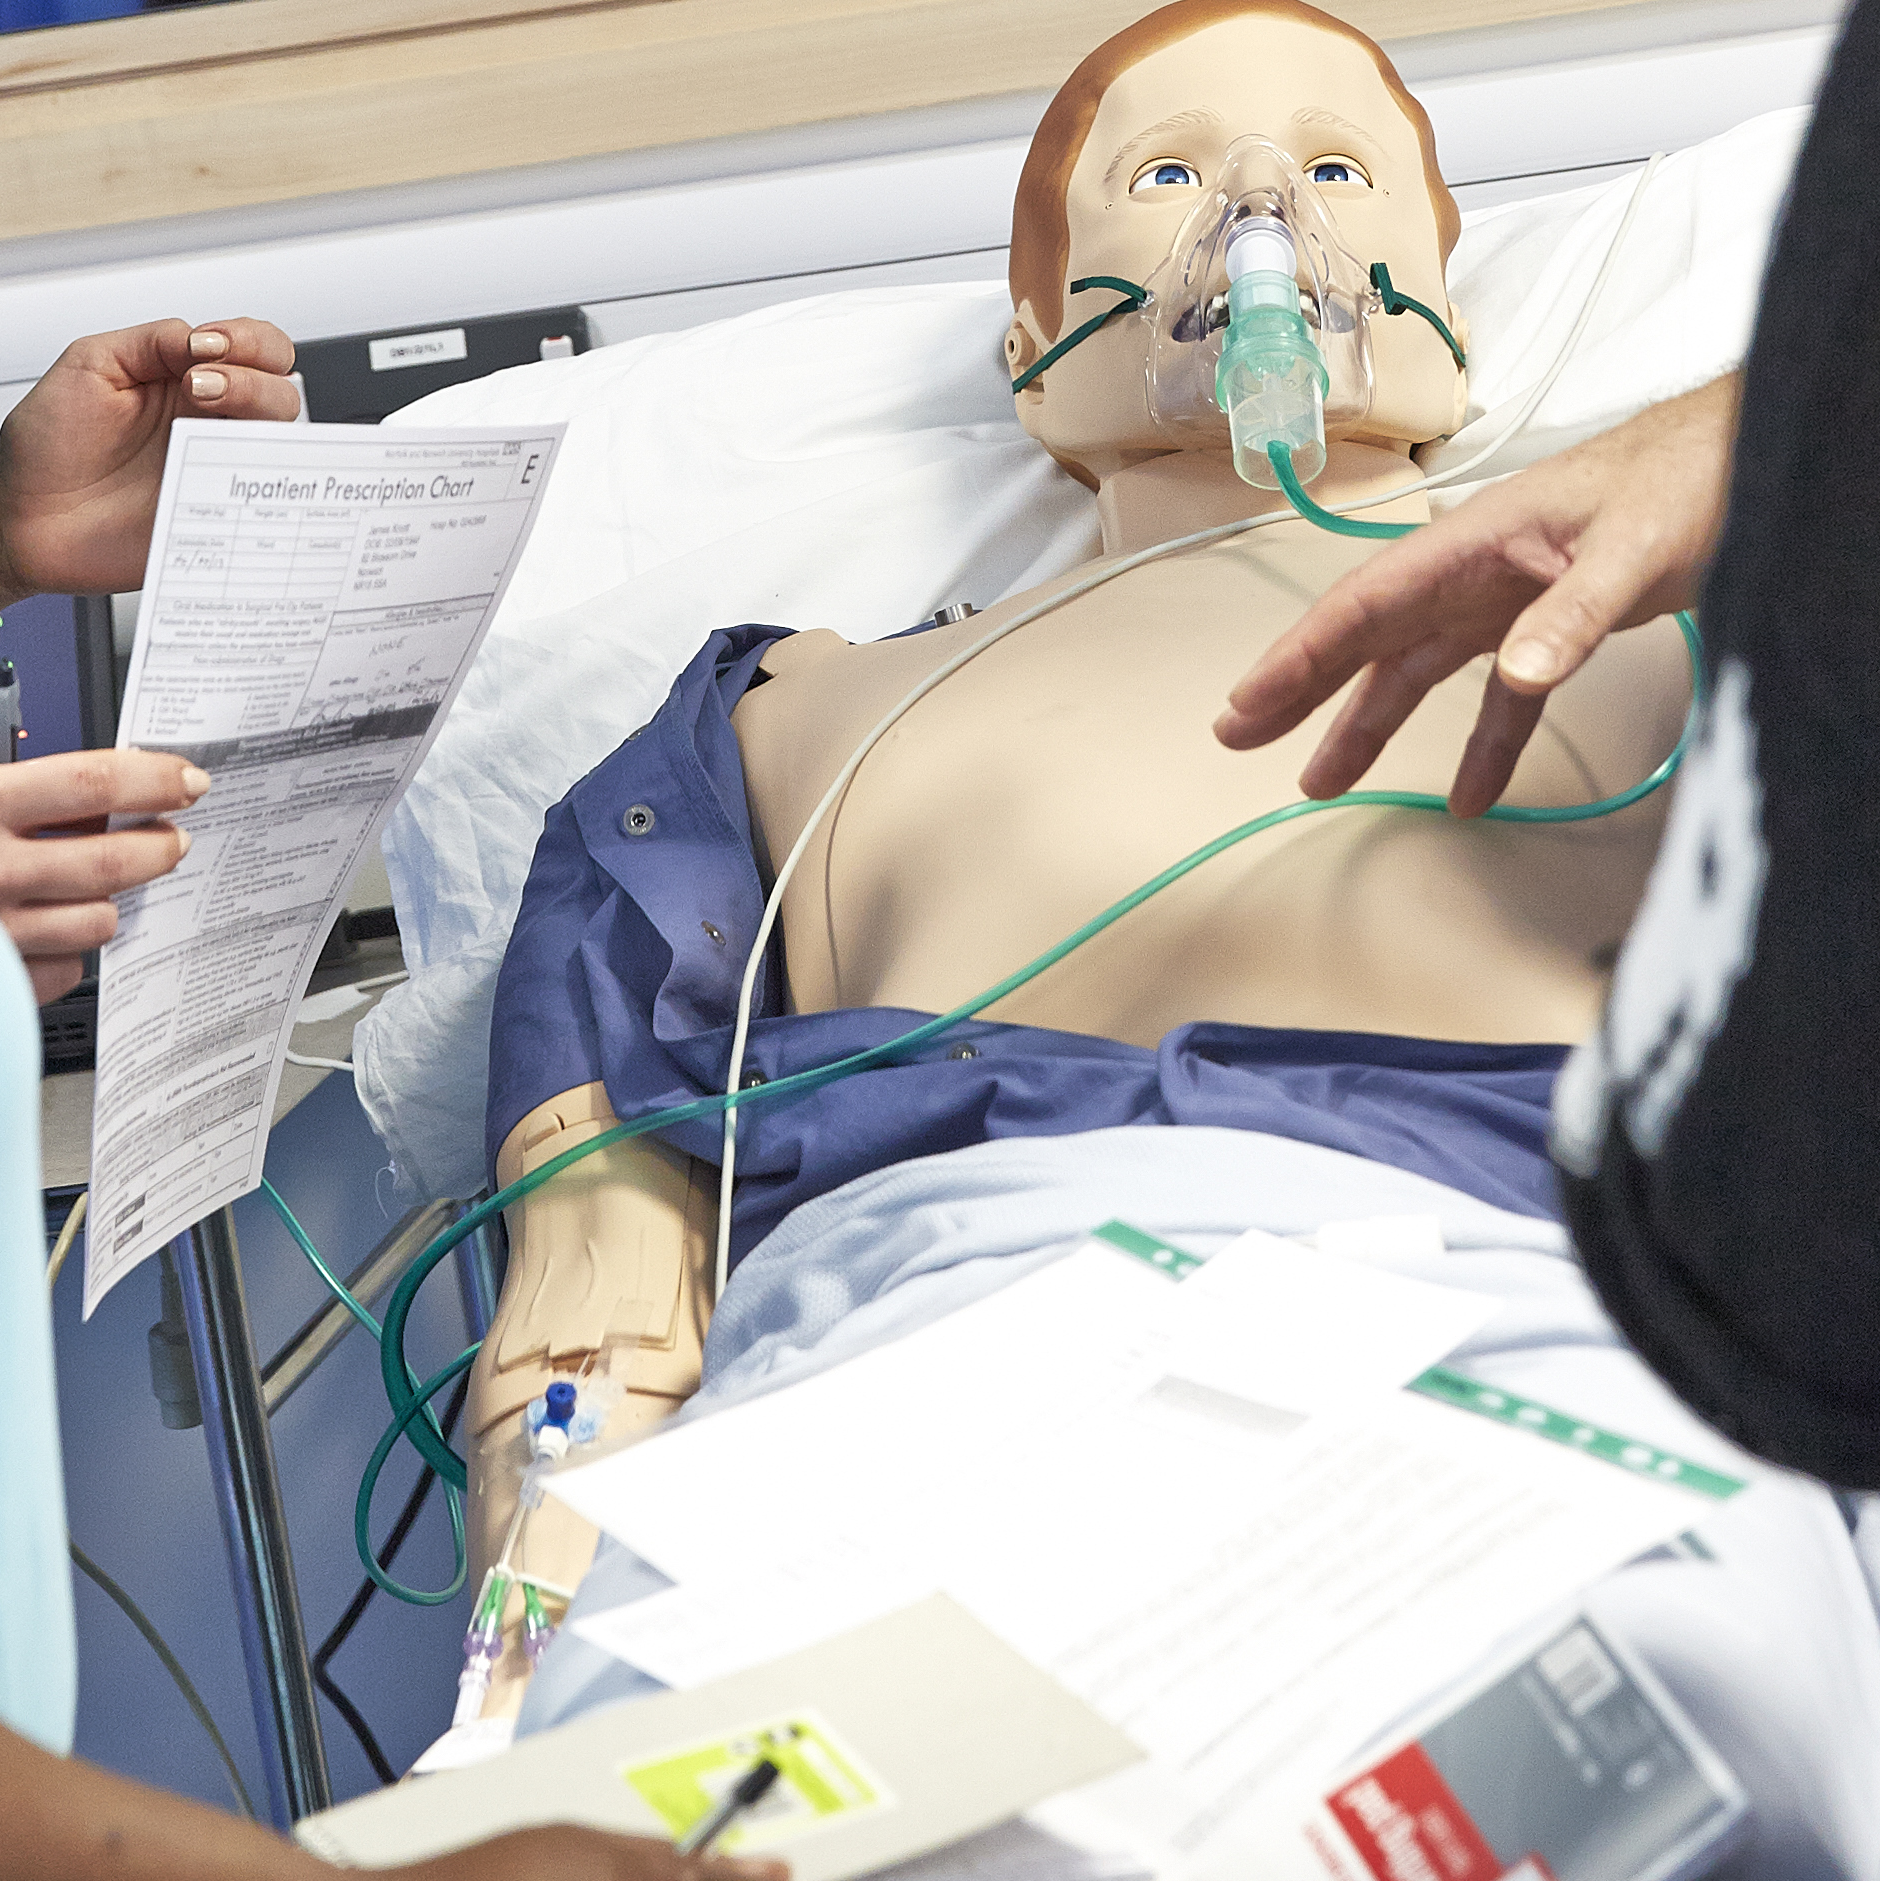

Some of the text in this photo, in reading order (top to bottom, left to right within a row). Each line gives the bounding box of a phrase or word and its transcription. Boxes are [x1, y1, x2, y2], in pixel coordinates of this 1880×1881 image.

[521, 453, 540, 485] E
[229, 472, 475, 507] Inpatient Prescription Chart
